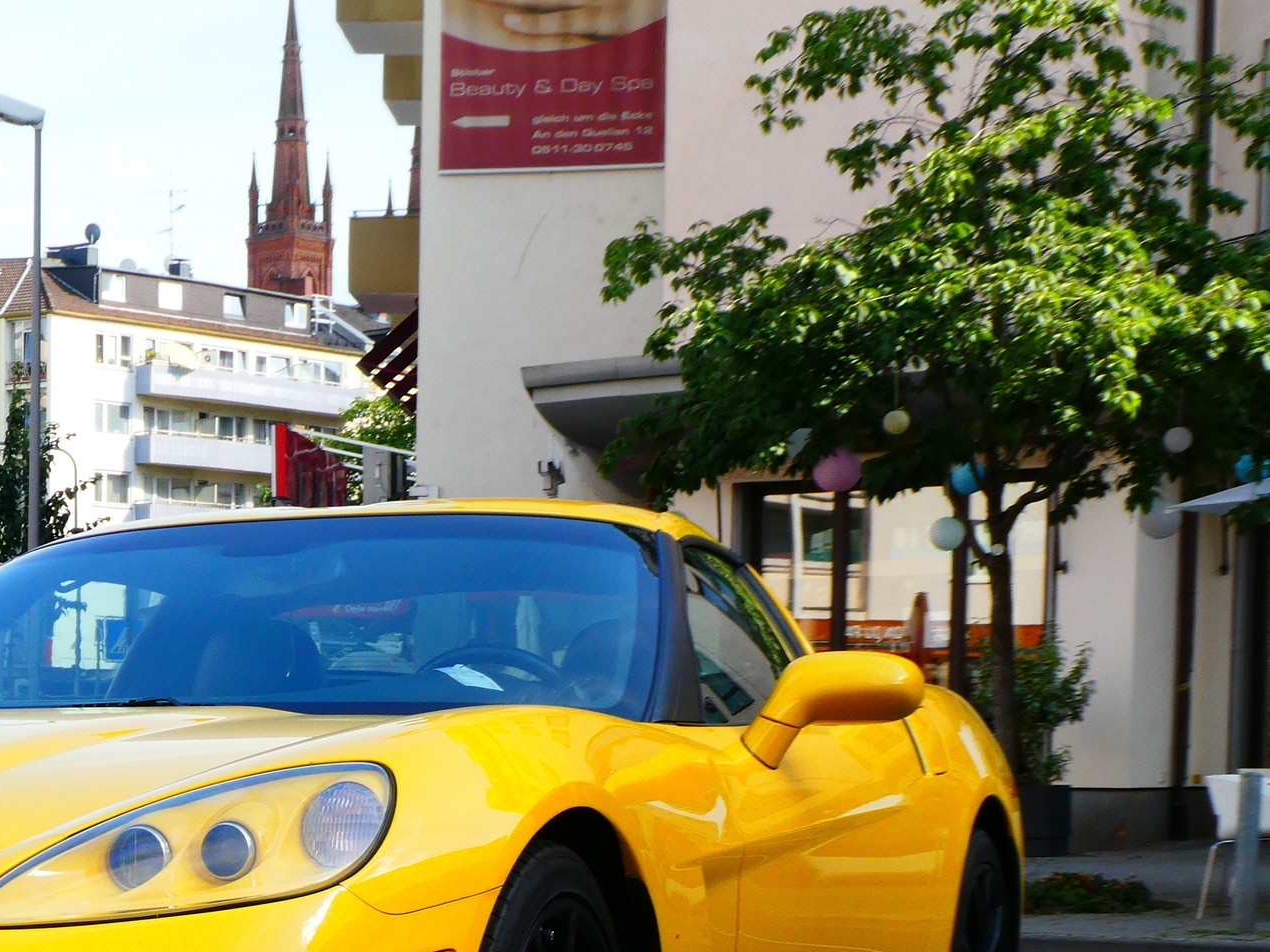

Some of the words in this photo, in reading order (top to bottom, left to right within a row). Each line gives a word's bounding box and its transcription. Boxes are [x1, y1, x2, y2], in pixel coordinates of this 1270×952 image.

[450, 82, 526, 98] Beauty
[534, 79, 553, 94] &
[560, 78, 603, 94] Day
[610, 76, 654, 93] Spa
[573, 114, 594, 123] um
[531, 129, 551, 140] An
[554, 128, 578, 138] den
[635, 125, 654, 135] 12
